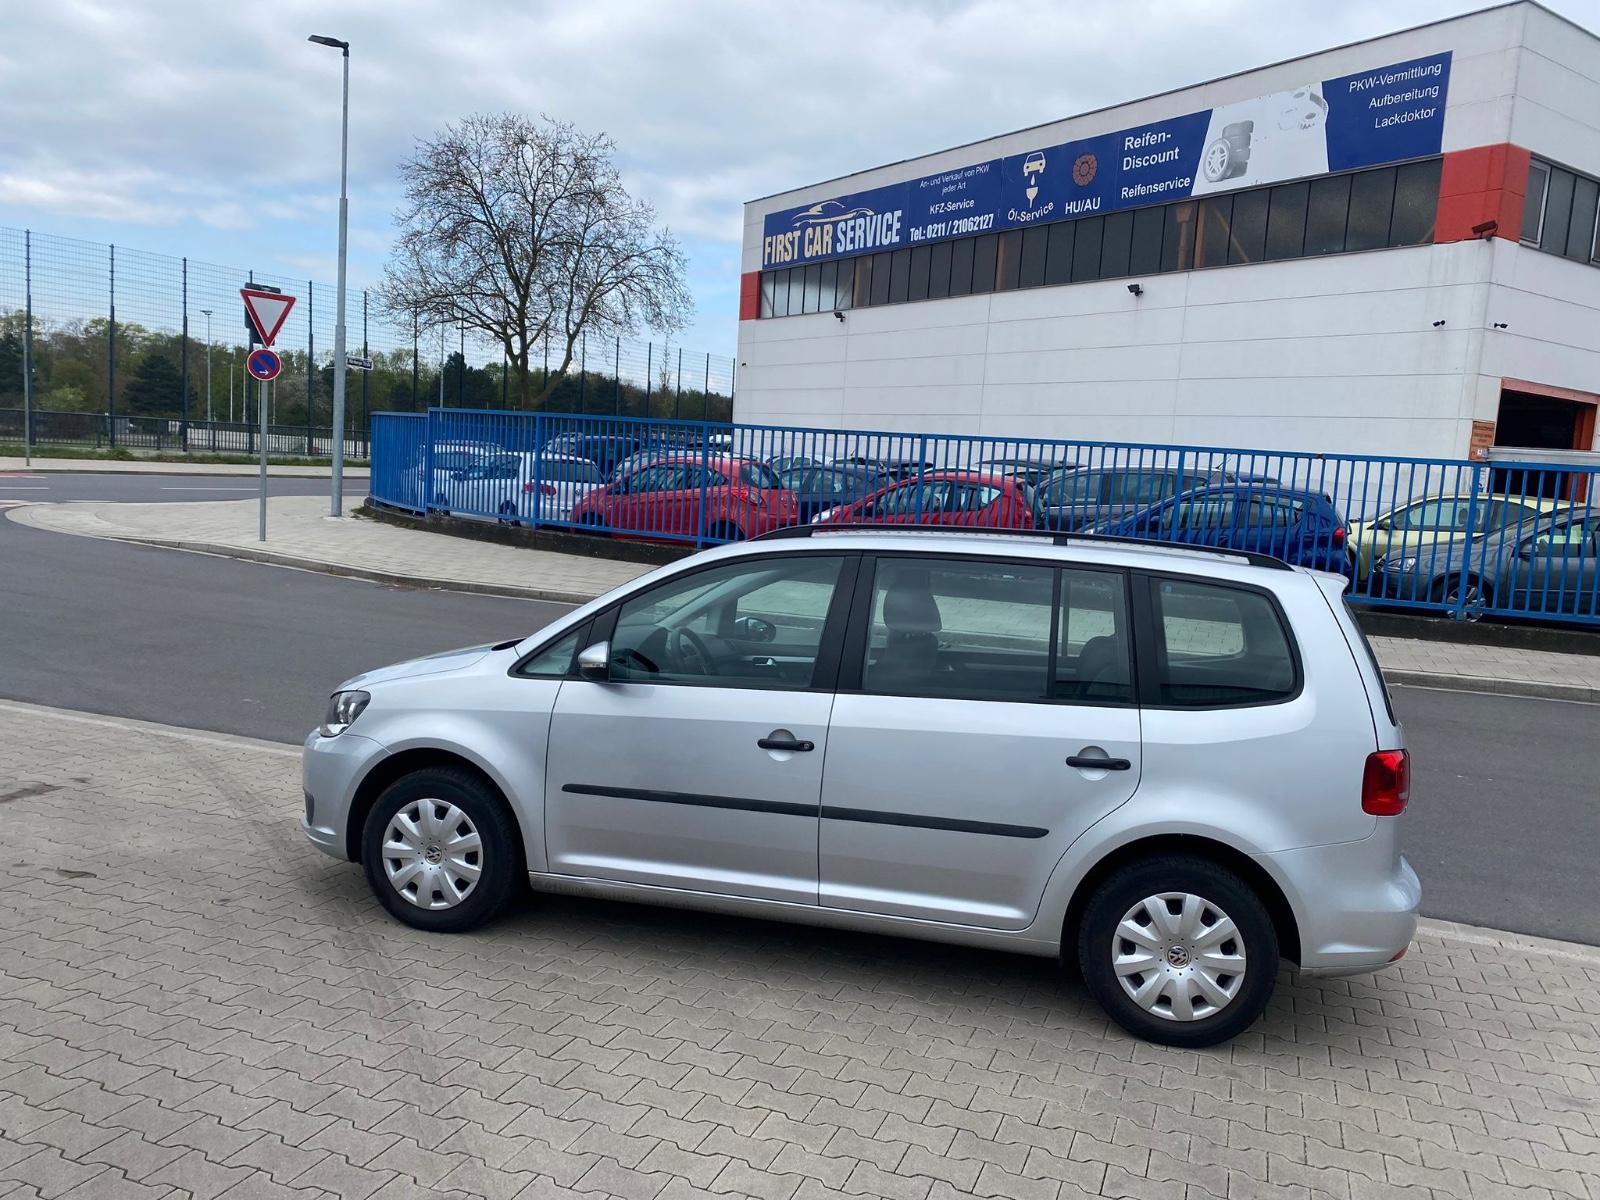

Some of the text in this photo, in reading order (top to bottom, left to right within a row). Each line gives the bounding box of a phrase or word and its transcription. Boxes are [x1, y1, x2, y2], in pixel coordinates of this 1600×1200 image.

[1349, 63, 1442, 93] PKW-Vermittlung
[1368, 84, 1440, 109] Aufbereitung
[1374, 107, 1436, 129] Lackdoktor
[1124, 131, 1172, 151] Reifen-
[1122, 146, 1180, 171] Discount
[930, 176, 941, 186] und
[941, 171, 963, 183] Verkauf
[964, 169, 975, 178] von
[975, 164, 990, 175] PKW
[942, 181, 966, 196] jeder Art
[1121, 176, 1191, 199] Reifenservice
[929, 198, 975, 215] KFZ-Service
[1007, 201, 1054, 223] Öl-Service
[1064, 197, 1101, 215] HU/AU
[926, 221, 946, 239] 0211
[952, 213, 994, 235] 21062127
[764, 209, 902, 266] FIRST CAR SERVICE
